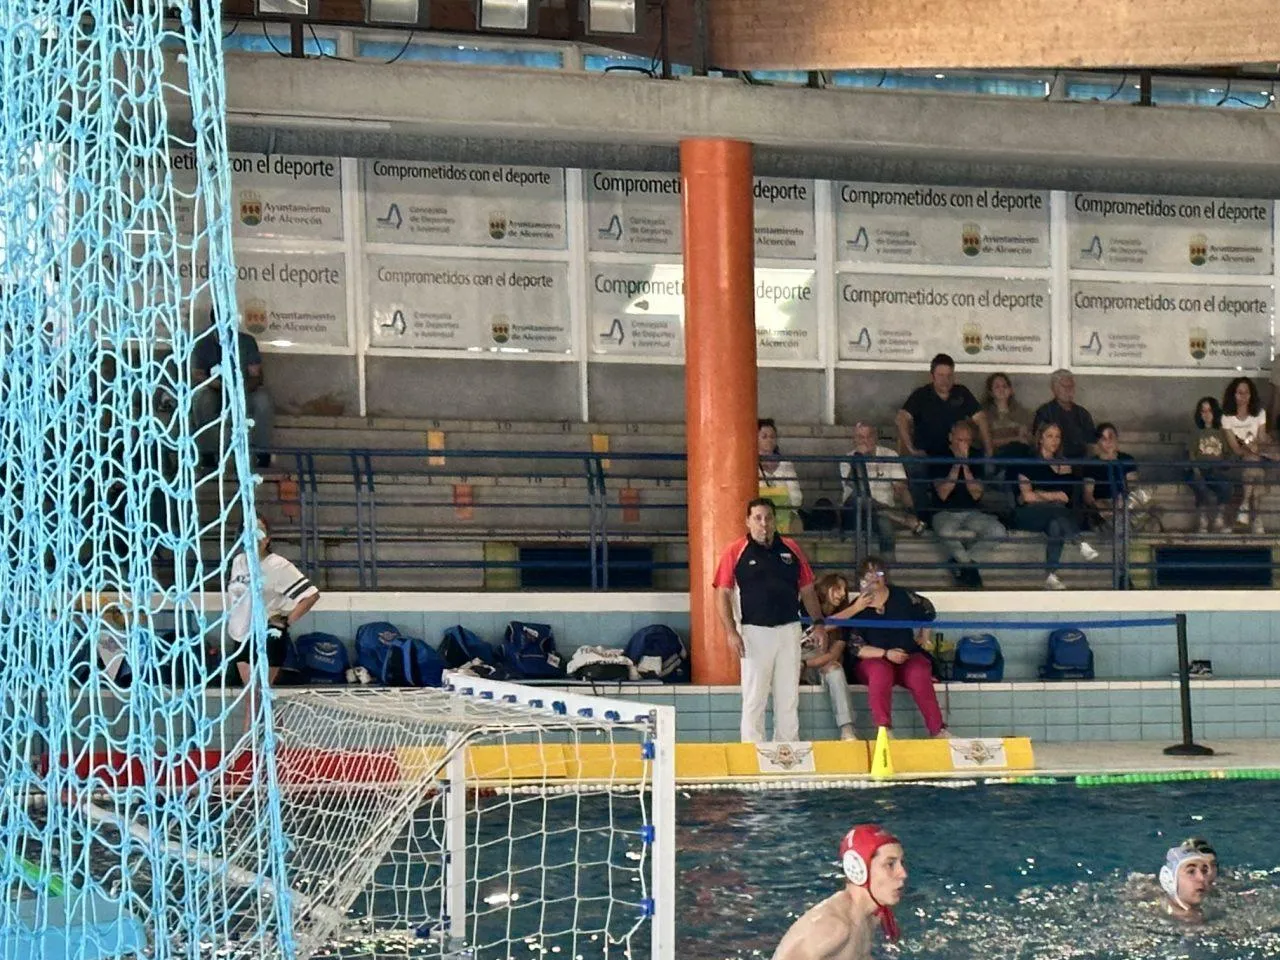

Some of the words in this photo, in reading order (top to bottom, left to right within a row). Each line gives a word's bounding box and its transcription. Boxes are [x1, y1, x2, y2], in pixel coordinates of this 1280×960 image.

[257, 154, 269, 173] el
[274, 156, 334, 180] deporte
[373, 160, 467, 182] Comprometidos
[469, 169, 490, 182] con
[492, 167, 503, 182] el
[505, 168, 551, 187] deporte
[593, 171, 681, 196] Comprometi
[753, 181, 807, 203] deporte
[841, 184, 947, 208] Comprometidos
[950, 193, 973, 208] con
[976, 190, 987, 208] el
[991, 191, 1042, 212] deporte
[263, 213, 276, 222] de
[1075, 193, 1176, 217] Comprometidos
[1179, 203, 1201, 218] con
[1203, 201, 1215, 218] el
[1218, 202, 1267, 223] deporte
[755, 227, 804, 237] untamiento
[262, 262, 275, 281] el
[280, 263, 339, 288] deporte
[378, 265, 471, 287] Comprometidos
[473, 273, 493, 287] con
[496, 272, 506, 287] el
[508, 272, 553, 290] deporte
[594, 273, 684, 298] Comprometi
[756, 281, 812, 304] deporte
[843, 284, 949, 308] Comprometidos
[951, 293, 974, 307] con
[978, 290, 989, 308] el
[992, 291, 1043, 311] deporte
[1074, 291, 1176, 314] Comprometidos
[1179, 298, 1201, 312] con
[1203, 295, 1215, 313] el
[1218, 296, 1267, 317] deporte
